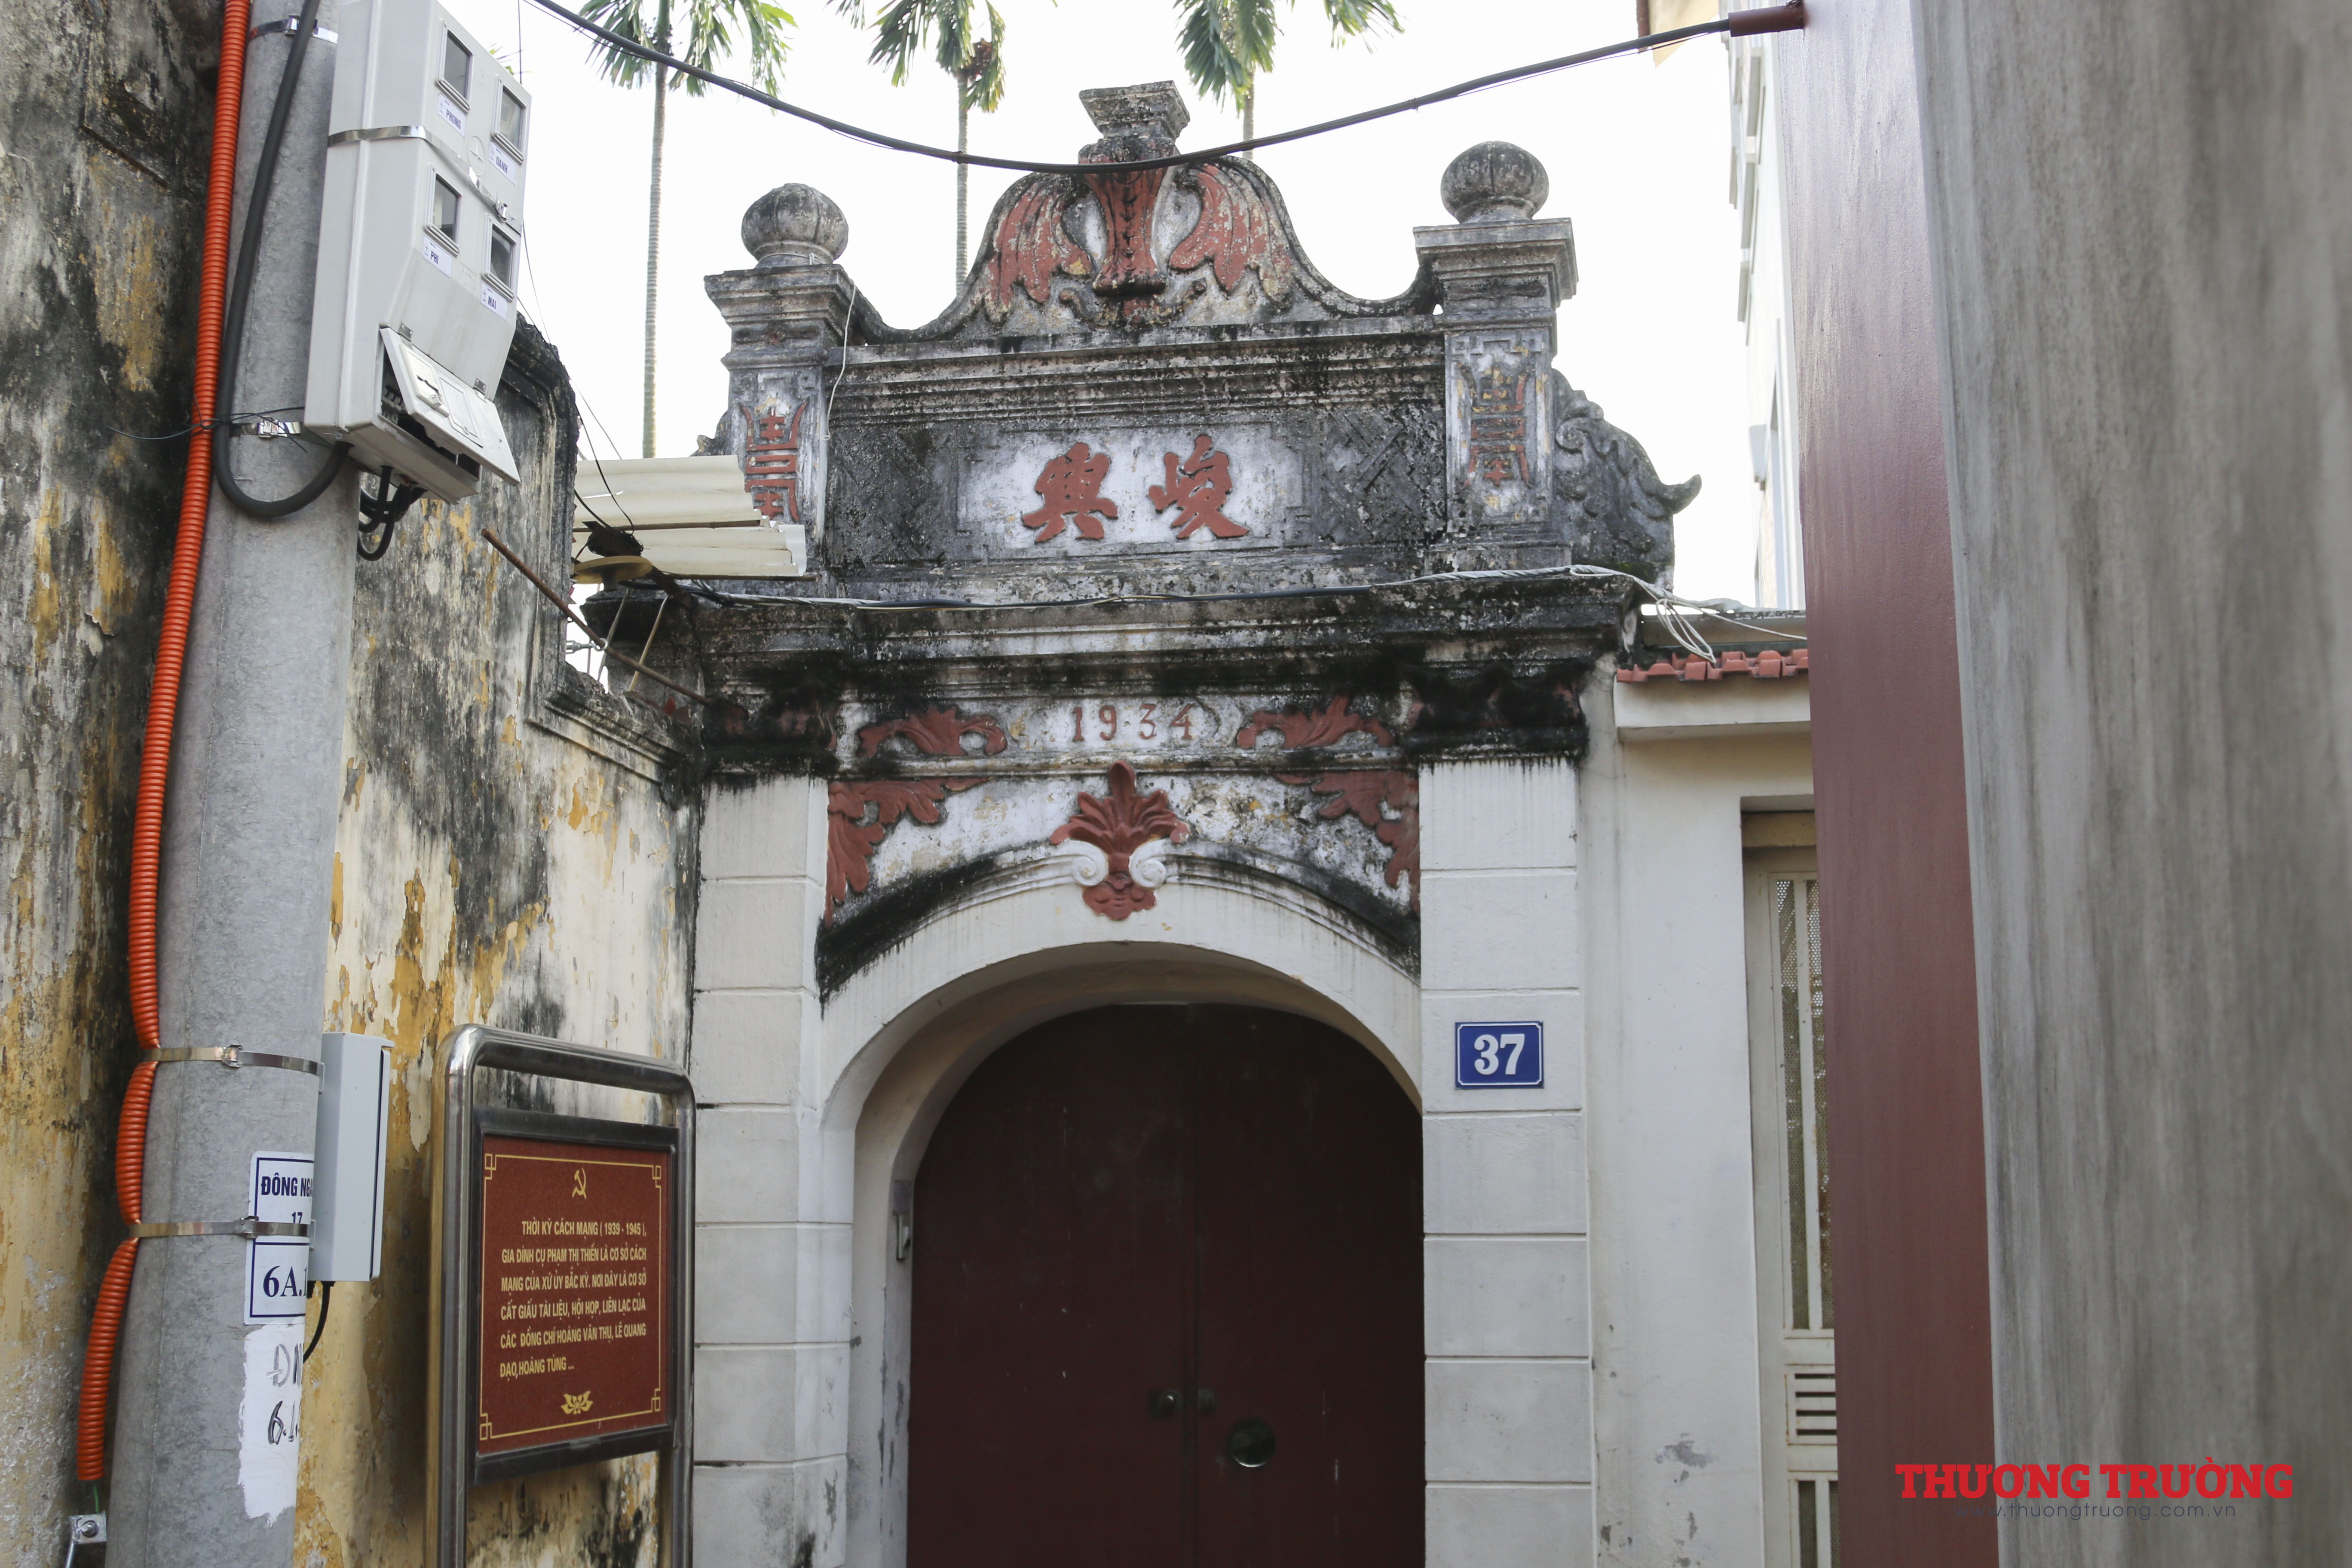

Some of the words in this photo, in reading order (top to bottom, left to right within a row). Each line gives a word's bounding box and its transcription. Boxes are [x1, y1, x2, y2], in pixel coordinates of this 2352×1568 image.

[446, 109, 462, 130] PHONG
[496, 156, 508, 174] OANH
[430, 251, 439, 265] PHI
[487, 295, 496, 310] MAI
[1073, 704, 1195, 741] 1934
[1474, 1034, 1525, 1075] 37
[261, 1172, 298, 1196] ĐÔNG
[522, 1217, 540, 1235] THỜI
[542, 1218, 552, 1235] KỲ
[554, 1217, 575, 1235] CÁCH
[576, 1222, 598, 1239] MẠNG
[604, 1222, 620, 1235] 1939
[626, 1223, 641, 1235] 1945
[502, 1249, 514, 1263] GIA
[516, 1245, 534, 1263] ĐÌNH
[536, 1248, 545, 1267] CỤ
[547, 1248, 567, 1266] PHẠM
[569, 1248, 579, 1265] THỊ
[600, 1245, 608, 1261] LÀ
[610, 1247, 619, 1261] CƠ
[620, 1242, 628, 1261] SỞ
[630, 1244, 646, 1260] CÁCH
[501, 1277, 523, 1295] MẠNG
[525, 1270, 540, 1290] CỦA
[592, 1274, 603, 1287] NƠI
[604, 1271, 618, 1287] ĐÂY
[619, 1270, 627, 1286] LÀ
[628, 1272, 637, 1286] CƠ
[638, 1268, 646, 1285] SỞ
[501, 1299, 517, 1320] CẤT
[518, 1298, 537, 1319] GIẤU
[539, 1300, 551, 1317] TÀI
[553, 1299, 570, 1320] LIỆU,
[572, 1298, 583, 1319] HỘI
[585, 1301, 600, 1318] HỌP,
[603, 1296, 616, 1313] LIÊN
[618, 1298, 631, 1316] LẠC
[632, 1293, 646, 1311] CỦA
[501, 1330, 516, 1348] CÁC
[521, 1326, 541, 1347] ĐỒNG
[543, 1327, 556, 1344] CHÍ
[557, 1326, 581, 1343] HOÀNG
[583, 1324, 597, 1341] VĂN
[599, 1326, 613, 1343] THỤ,
[615, 1321, 622, 1338] LÊ
[624, 1323, 646, 1337] QUANG
[547, 1354, 566, 1372] TÙNG
